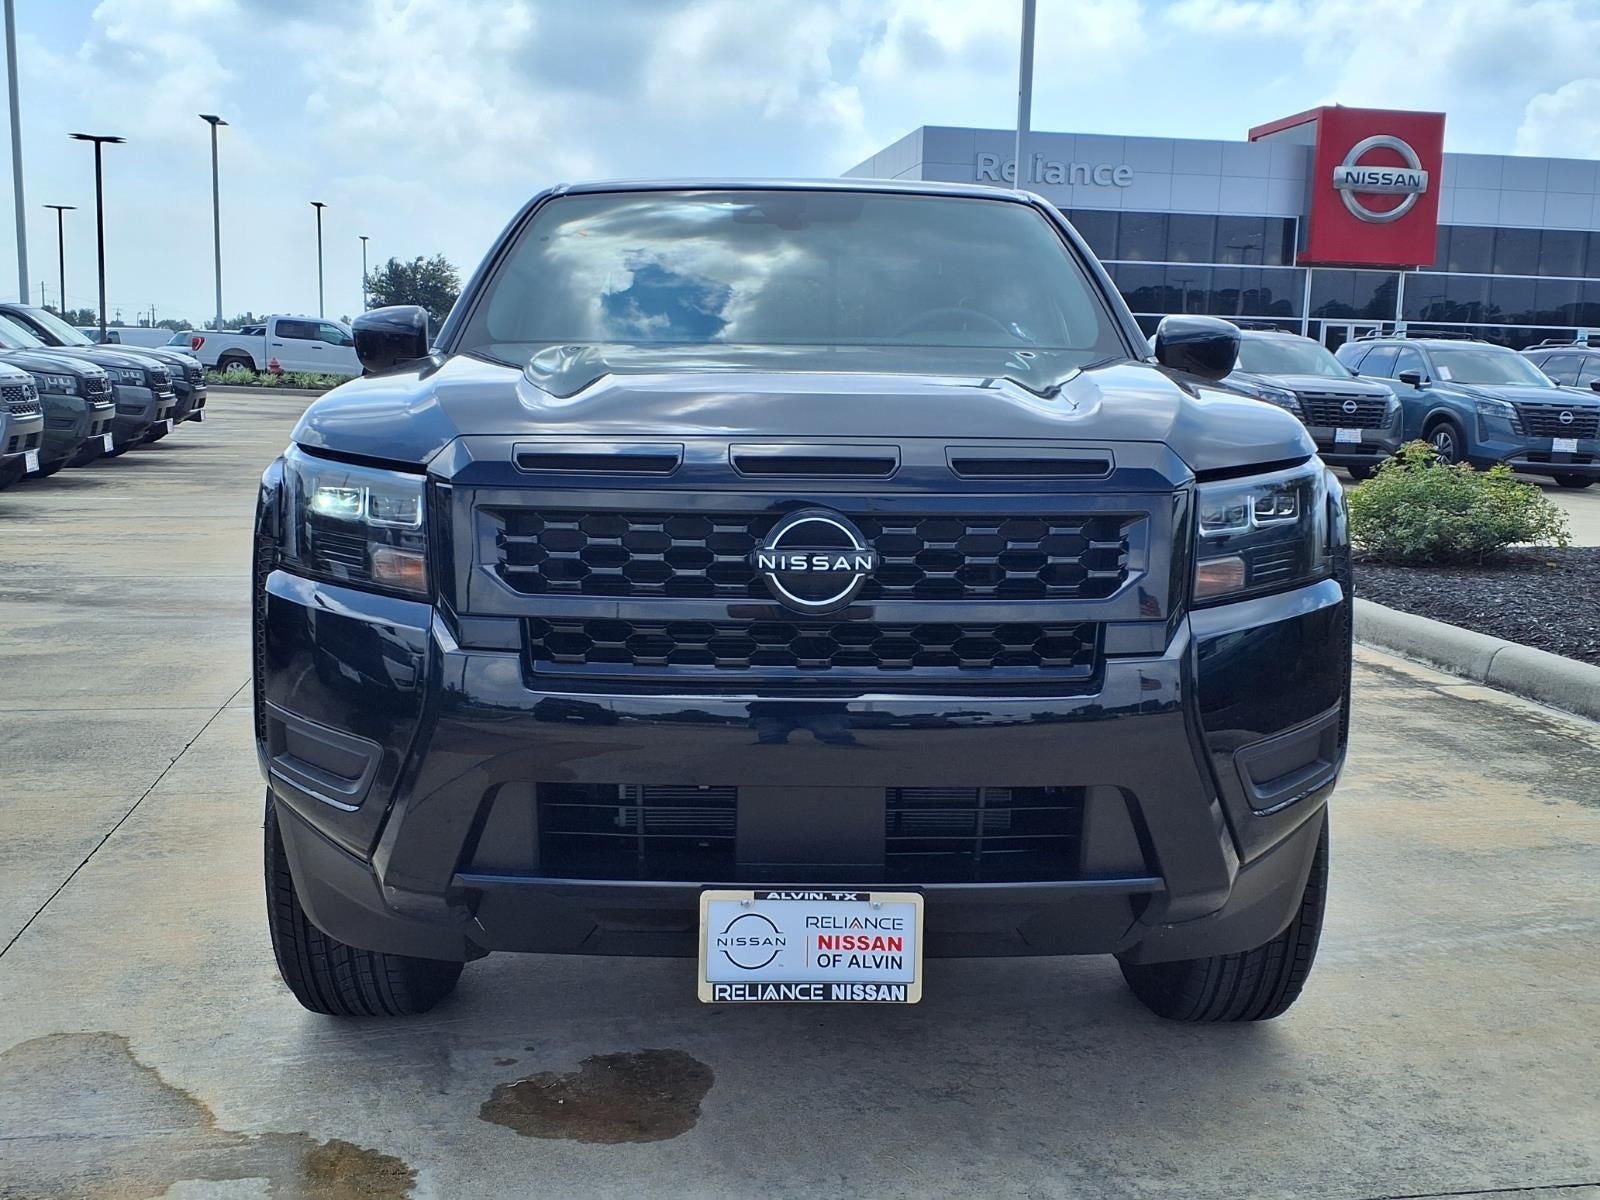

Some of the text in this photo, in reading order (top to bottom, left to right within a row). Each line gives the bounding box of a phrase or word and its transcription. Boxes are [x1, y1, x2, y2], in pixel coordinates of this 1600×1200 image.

[1345, 171, 1420, 187] NISSAN
[758, 554, 872, 570] NISSAN
[806, 916, 904, 930] RELIANCE
[717, 937, 786, 946] NISSAN
[818, 935, 903, 952] NISSAN
[817, 953, 903, 970] OF ALVIN
[715, 984, 905, 1001] RELIANCE NISSAN
